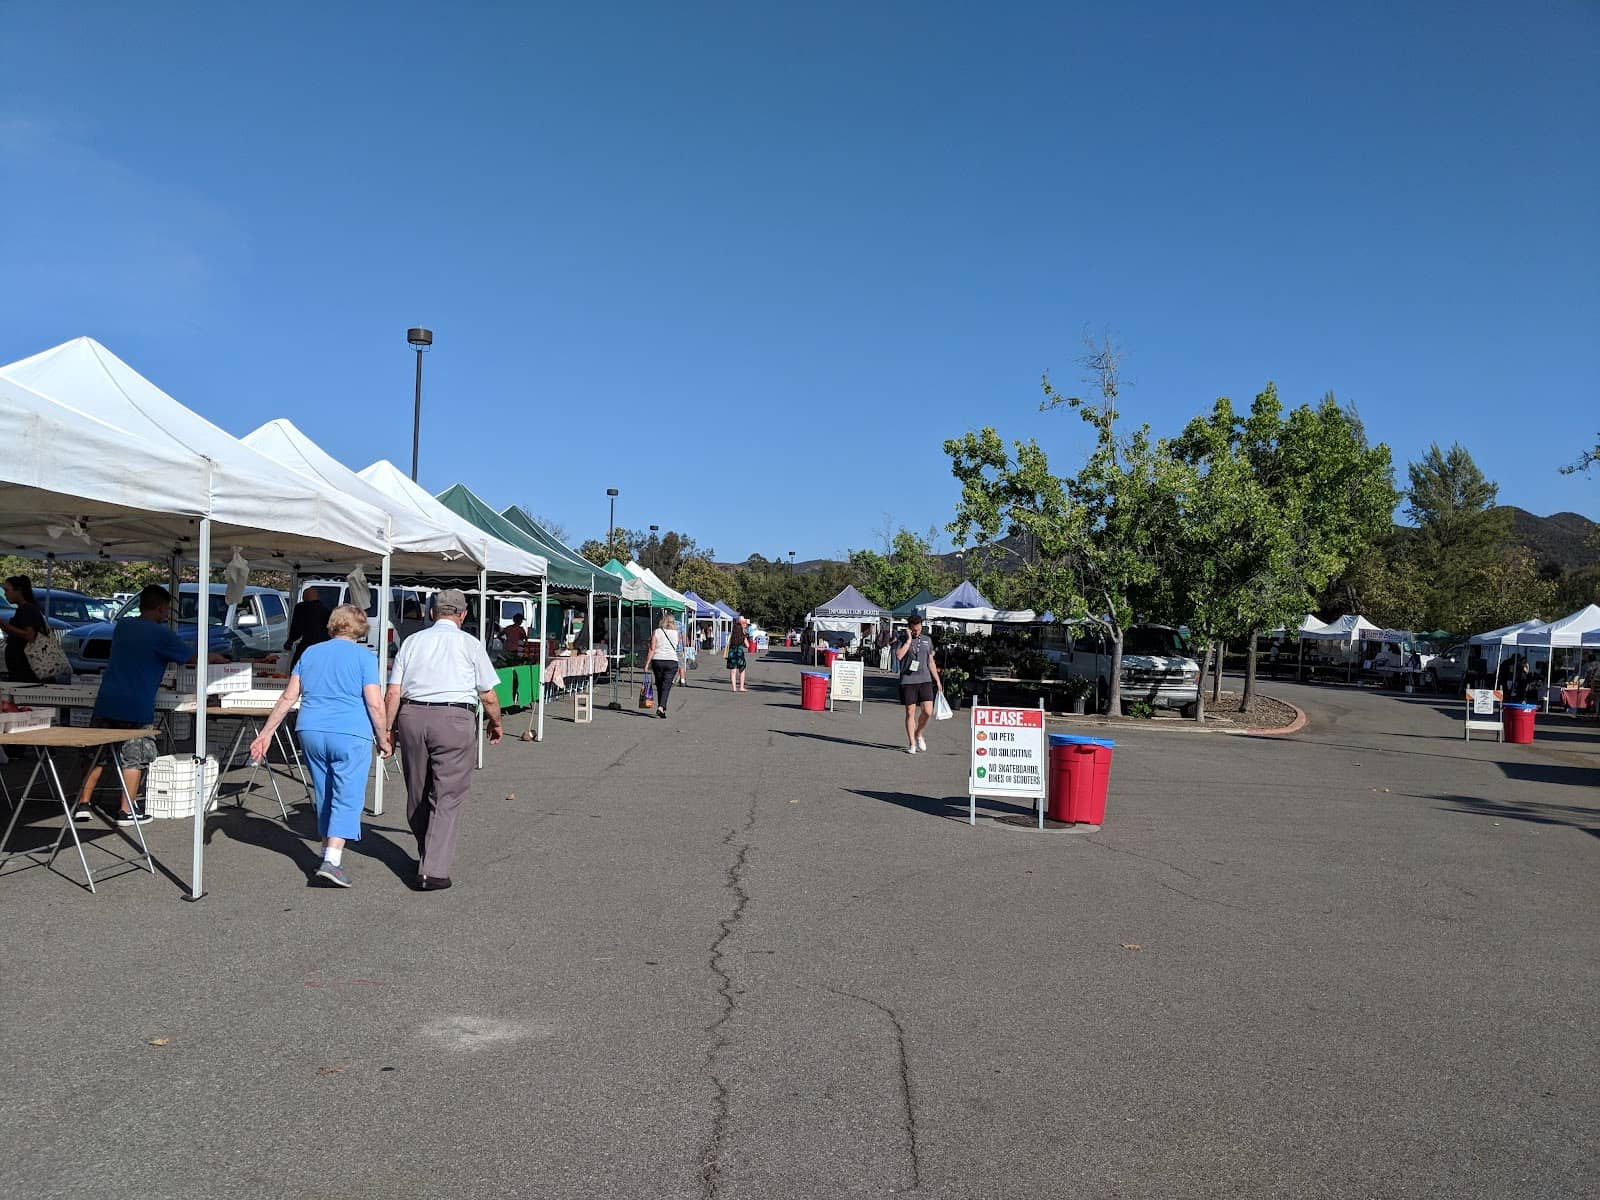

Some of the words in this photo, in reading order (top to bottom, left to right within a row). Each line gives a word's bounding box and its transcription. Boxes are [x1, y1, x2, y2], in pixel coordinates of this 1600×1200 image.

[976, 710, 1037, 727] PLEASE...
[989, 732, 998, 741] NO
[1000, 733, 1015, 742] PETS
[989, 748, 998, 757] NO
[999, 748, 1032, 758] SOLICITING
[989, 763, 997, 773] NO
[988, 774, 1005, 783] BIKES
[1013, 775, 1041, 785] SCOOTERS
